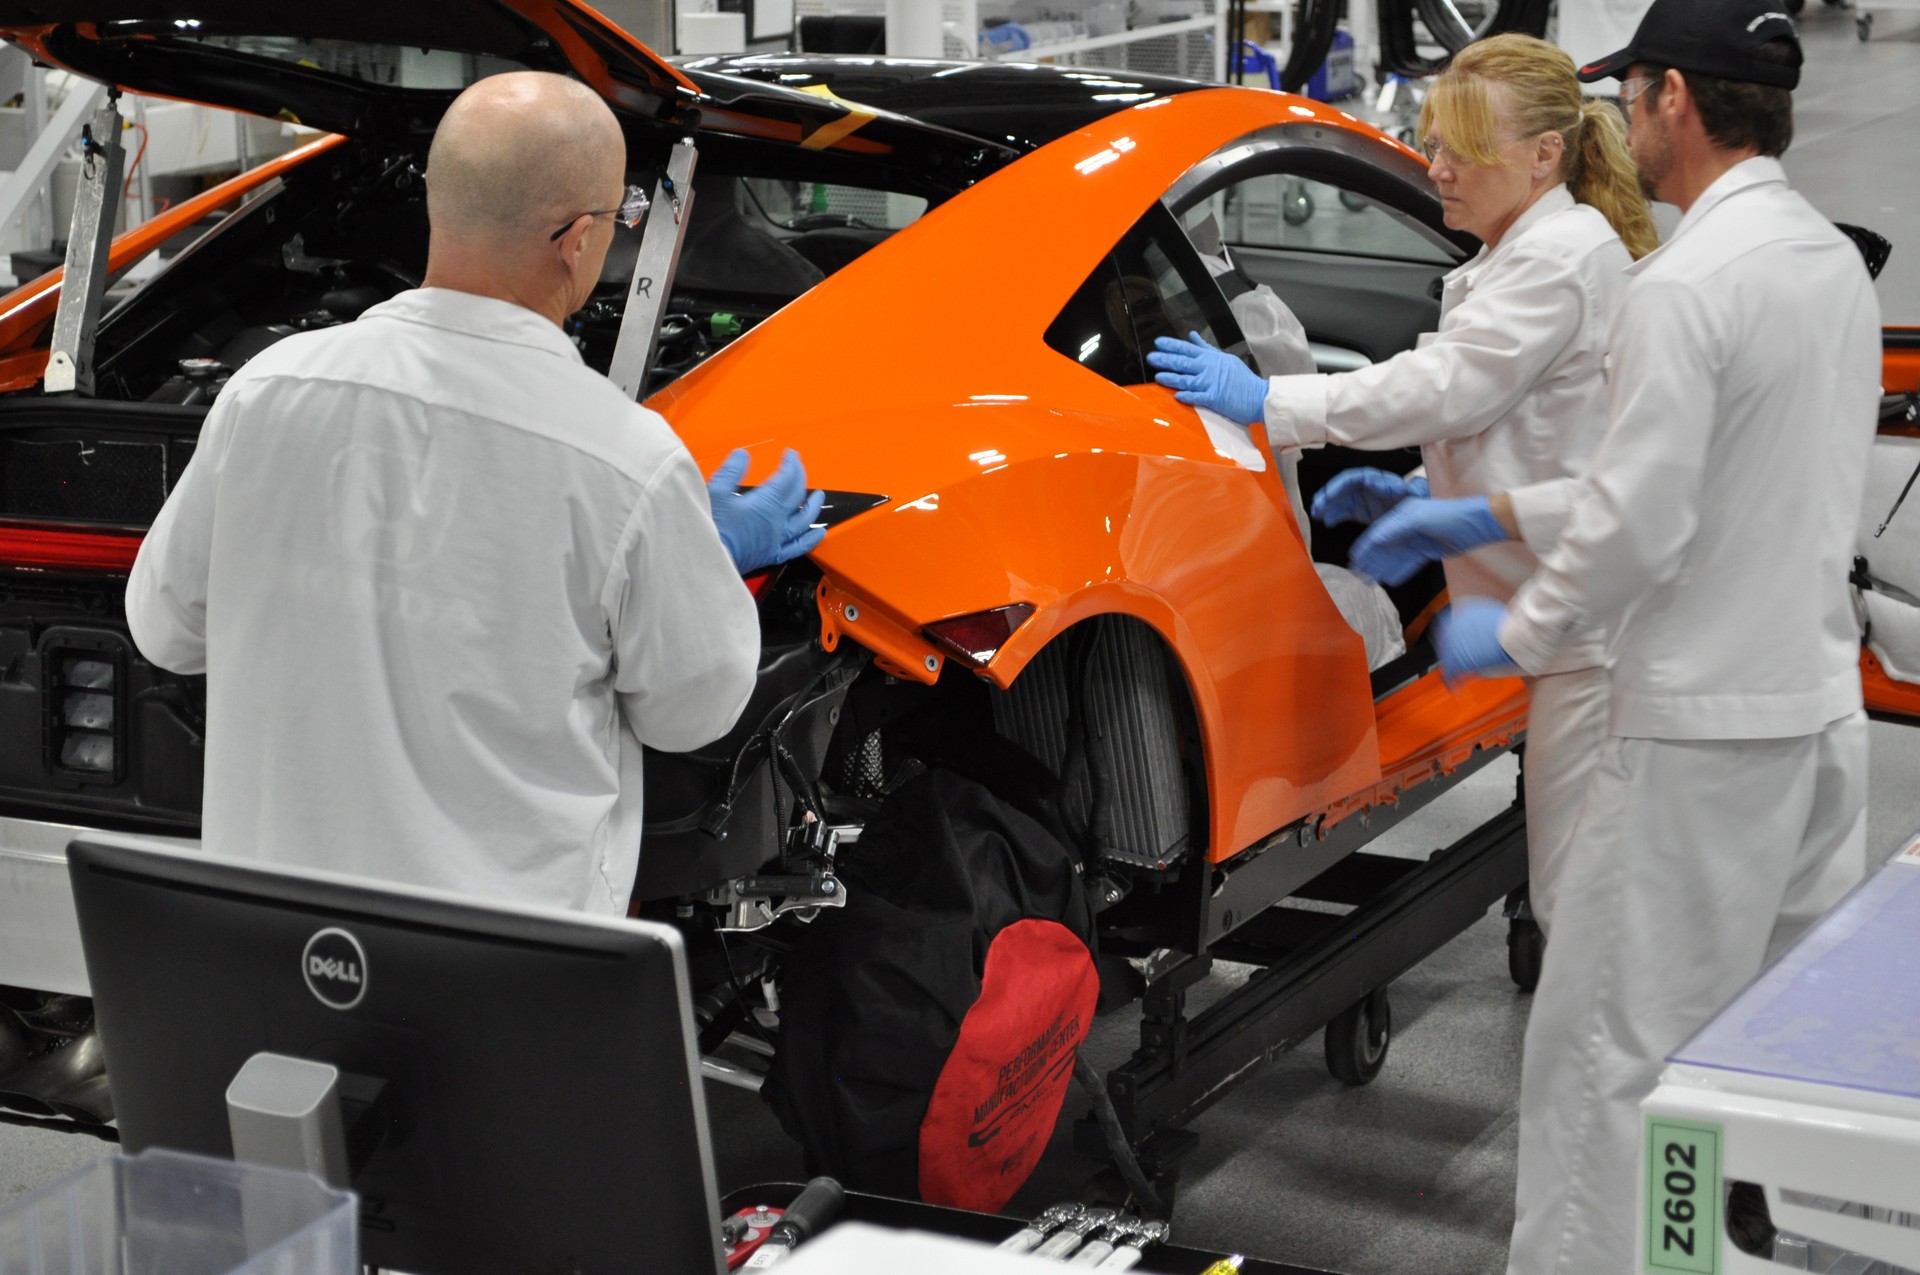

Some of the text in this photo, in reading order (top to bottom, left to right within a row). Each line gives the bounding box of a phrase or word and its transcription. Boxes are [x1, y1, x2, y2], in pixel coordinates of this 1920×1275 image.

[636, 277, 652, 299] R
[310, 955, 360, 984] DELL
[1663, 1142, 1697, 1257] Z602
